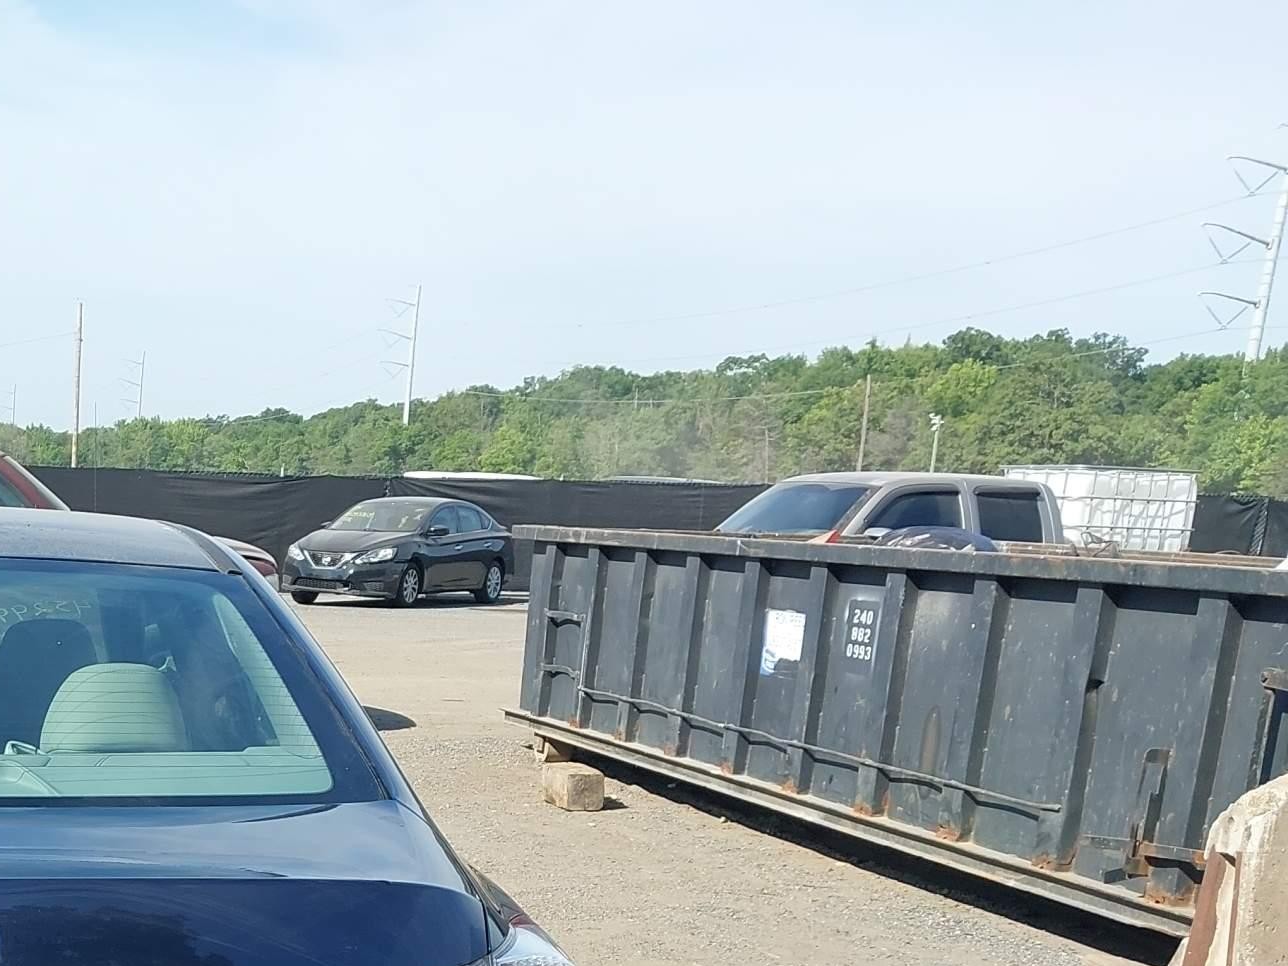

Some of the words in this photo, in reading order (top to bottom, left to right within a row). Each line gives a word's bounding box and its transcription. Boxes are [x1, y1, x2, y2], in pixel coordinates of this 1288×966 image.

[853, 609, 873, 625] 240
[851, 626, 871, 643] 882
[846, 643, 872, 660] 0993
